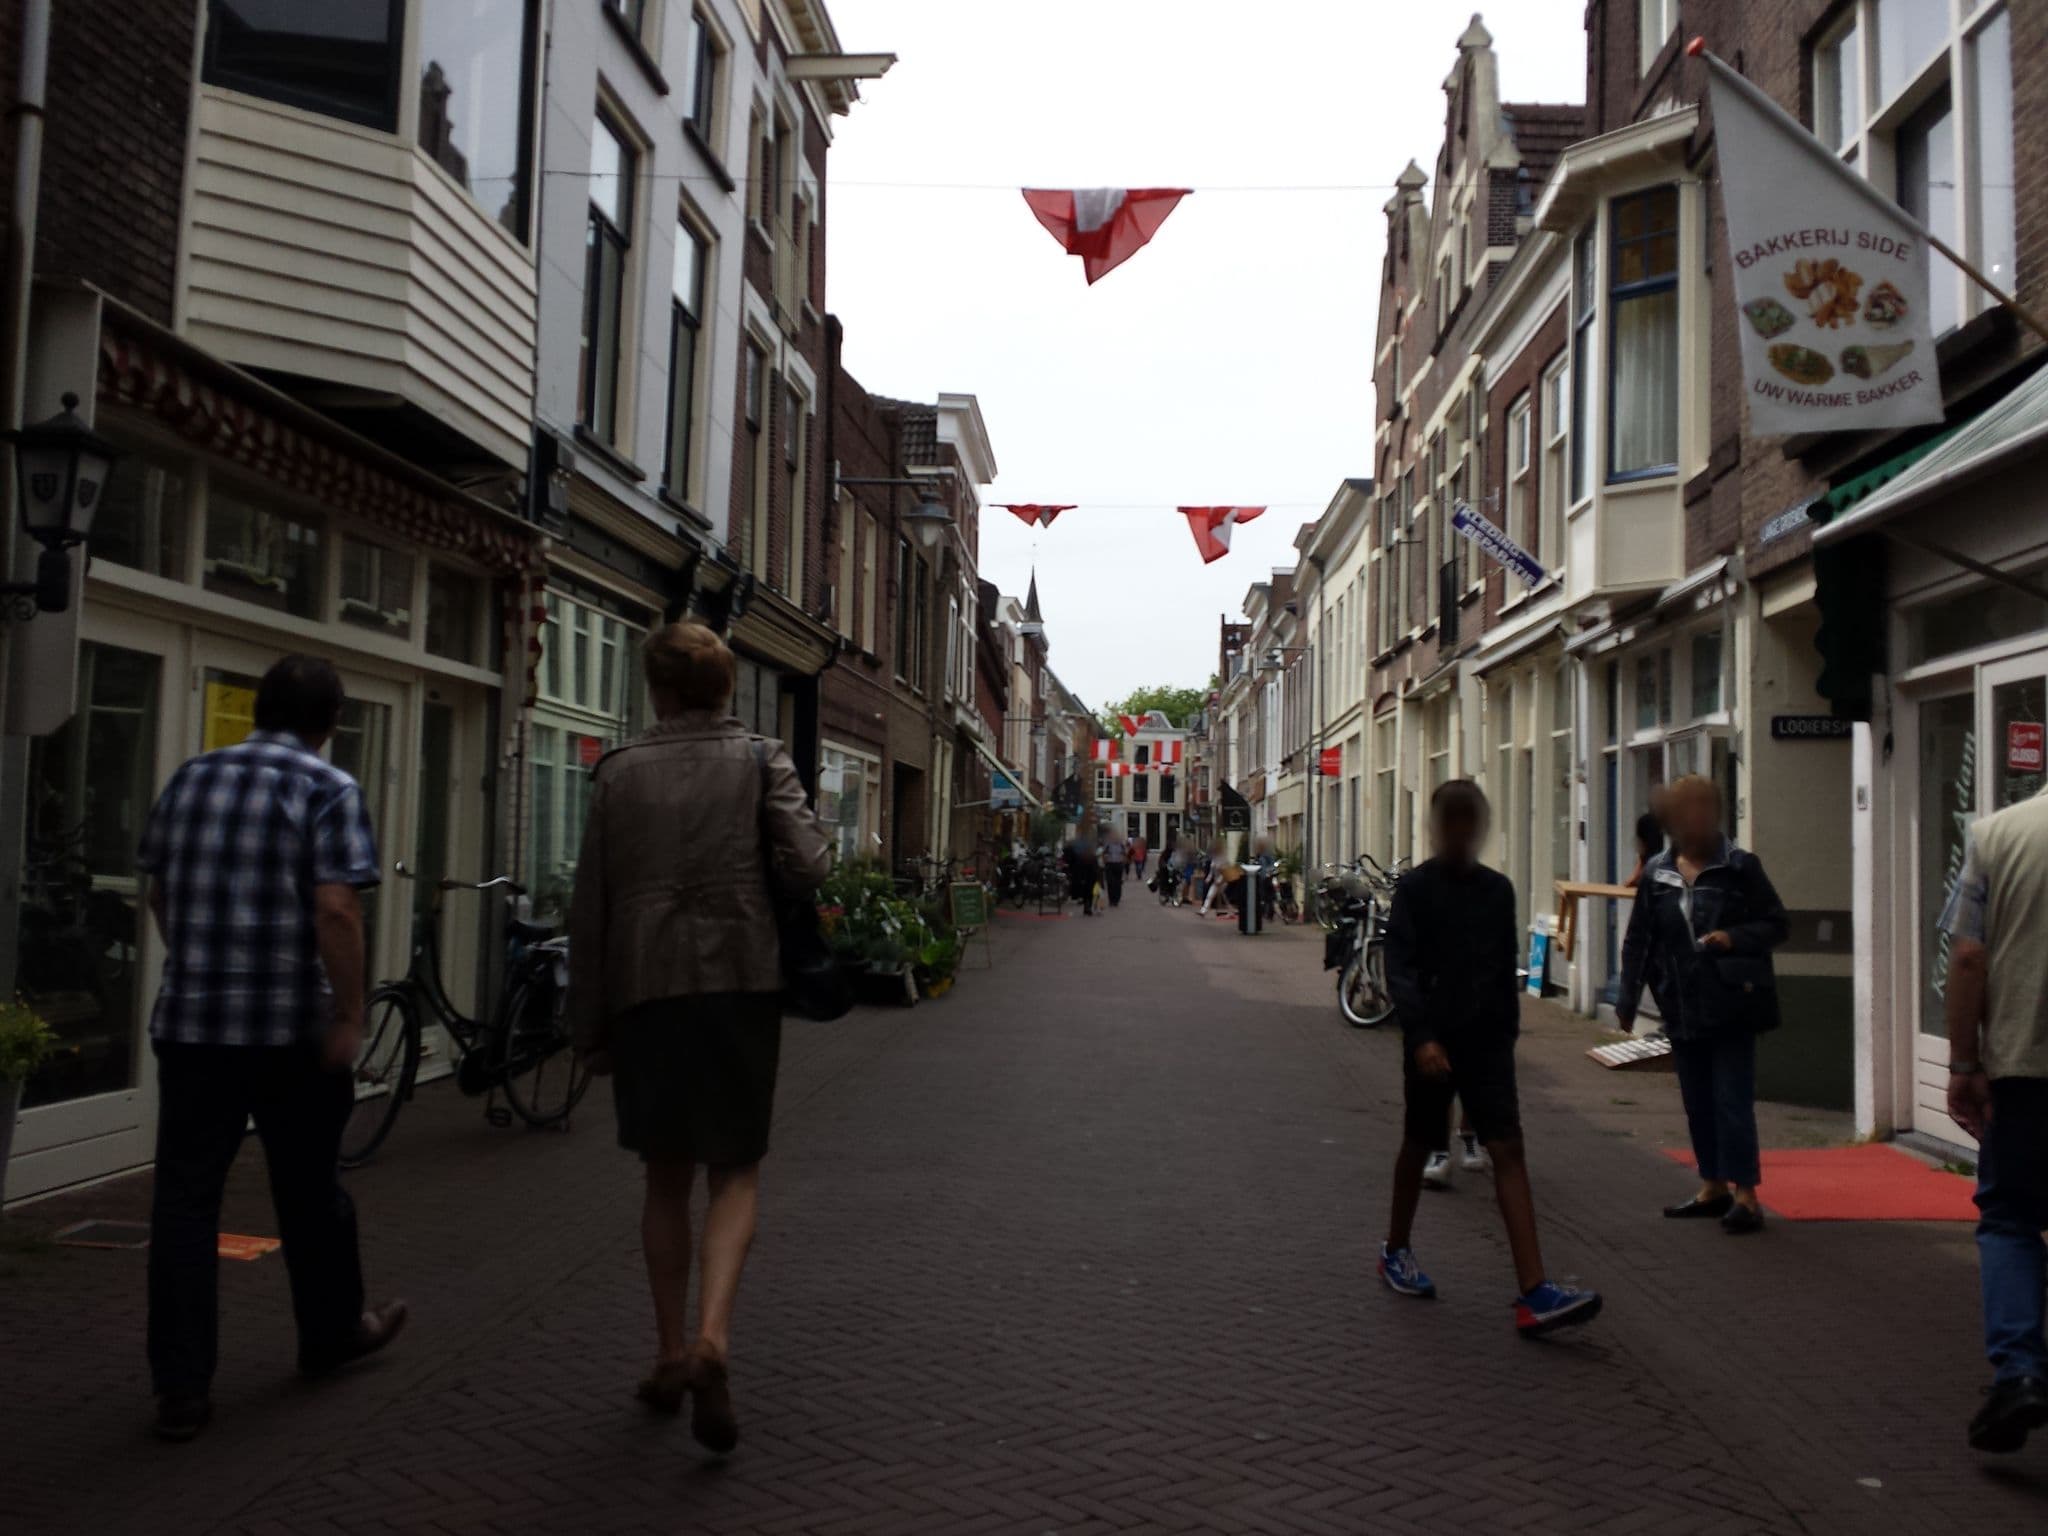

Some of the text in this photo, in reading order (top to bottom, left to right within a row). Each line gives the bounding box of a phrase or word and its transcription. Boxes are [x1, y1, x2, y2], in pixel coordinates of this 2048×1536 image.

[1735, 229, 1912, 269] BAKKERIJ SIDE
[1753, 370, 1923, 408] UW WARME BAKKER
